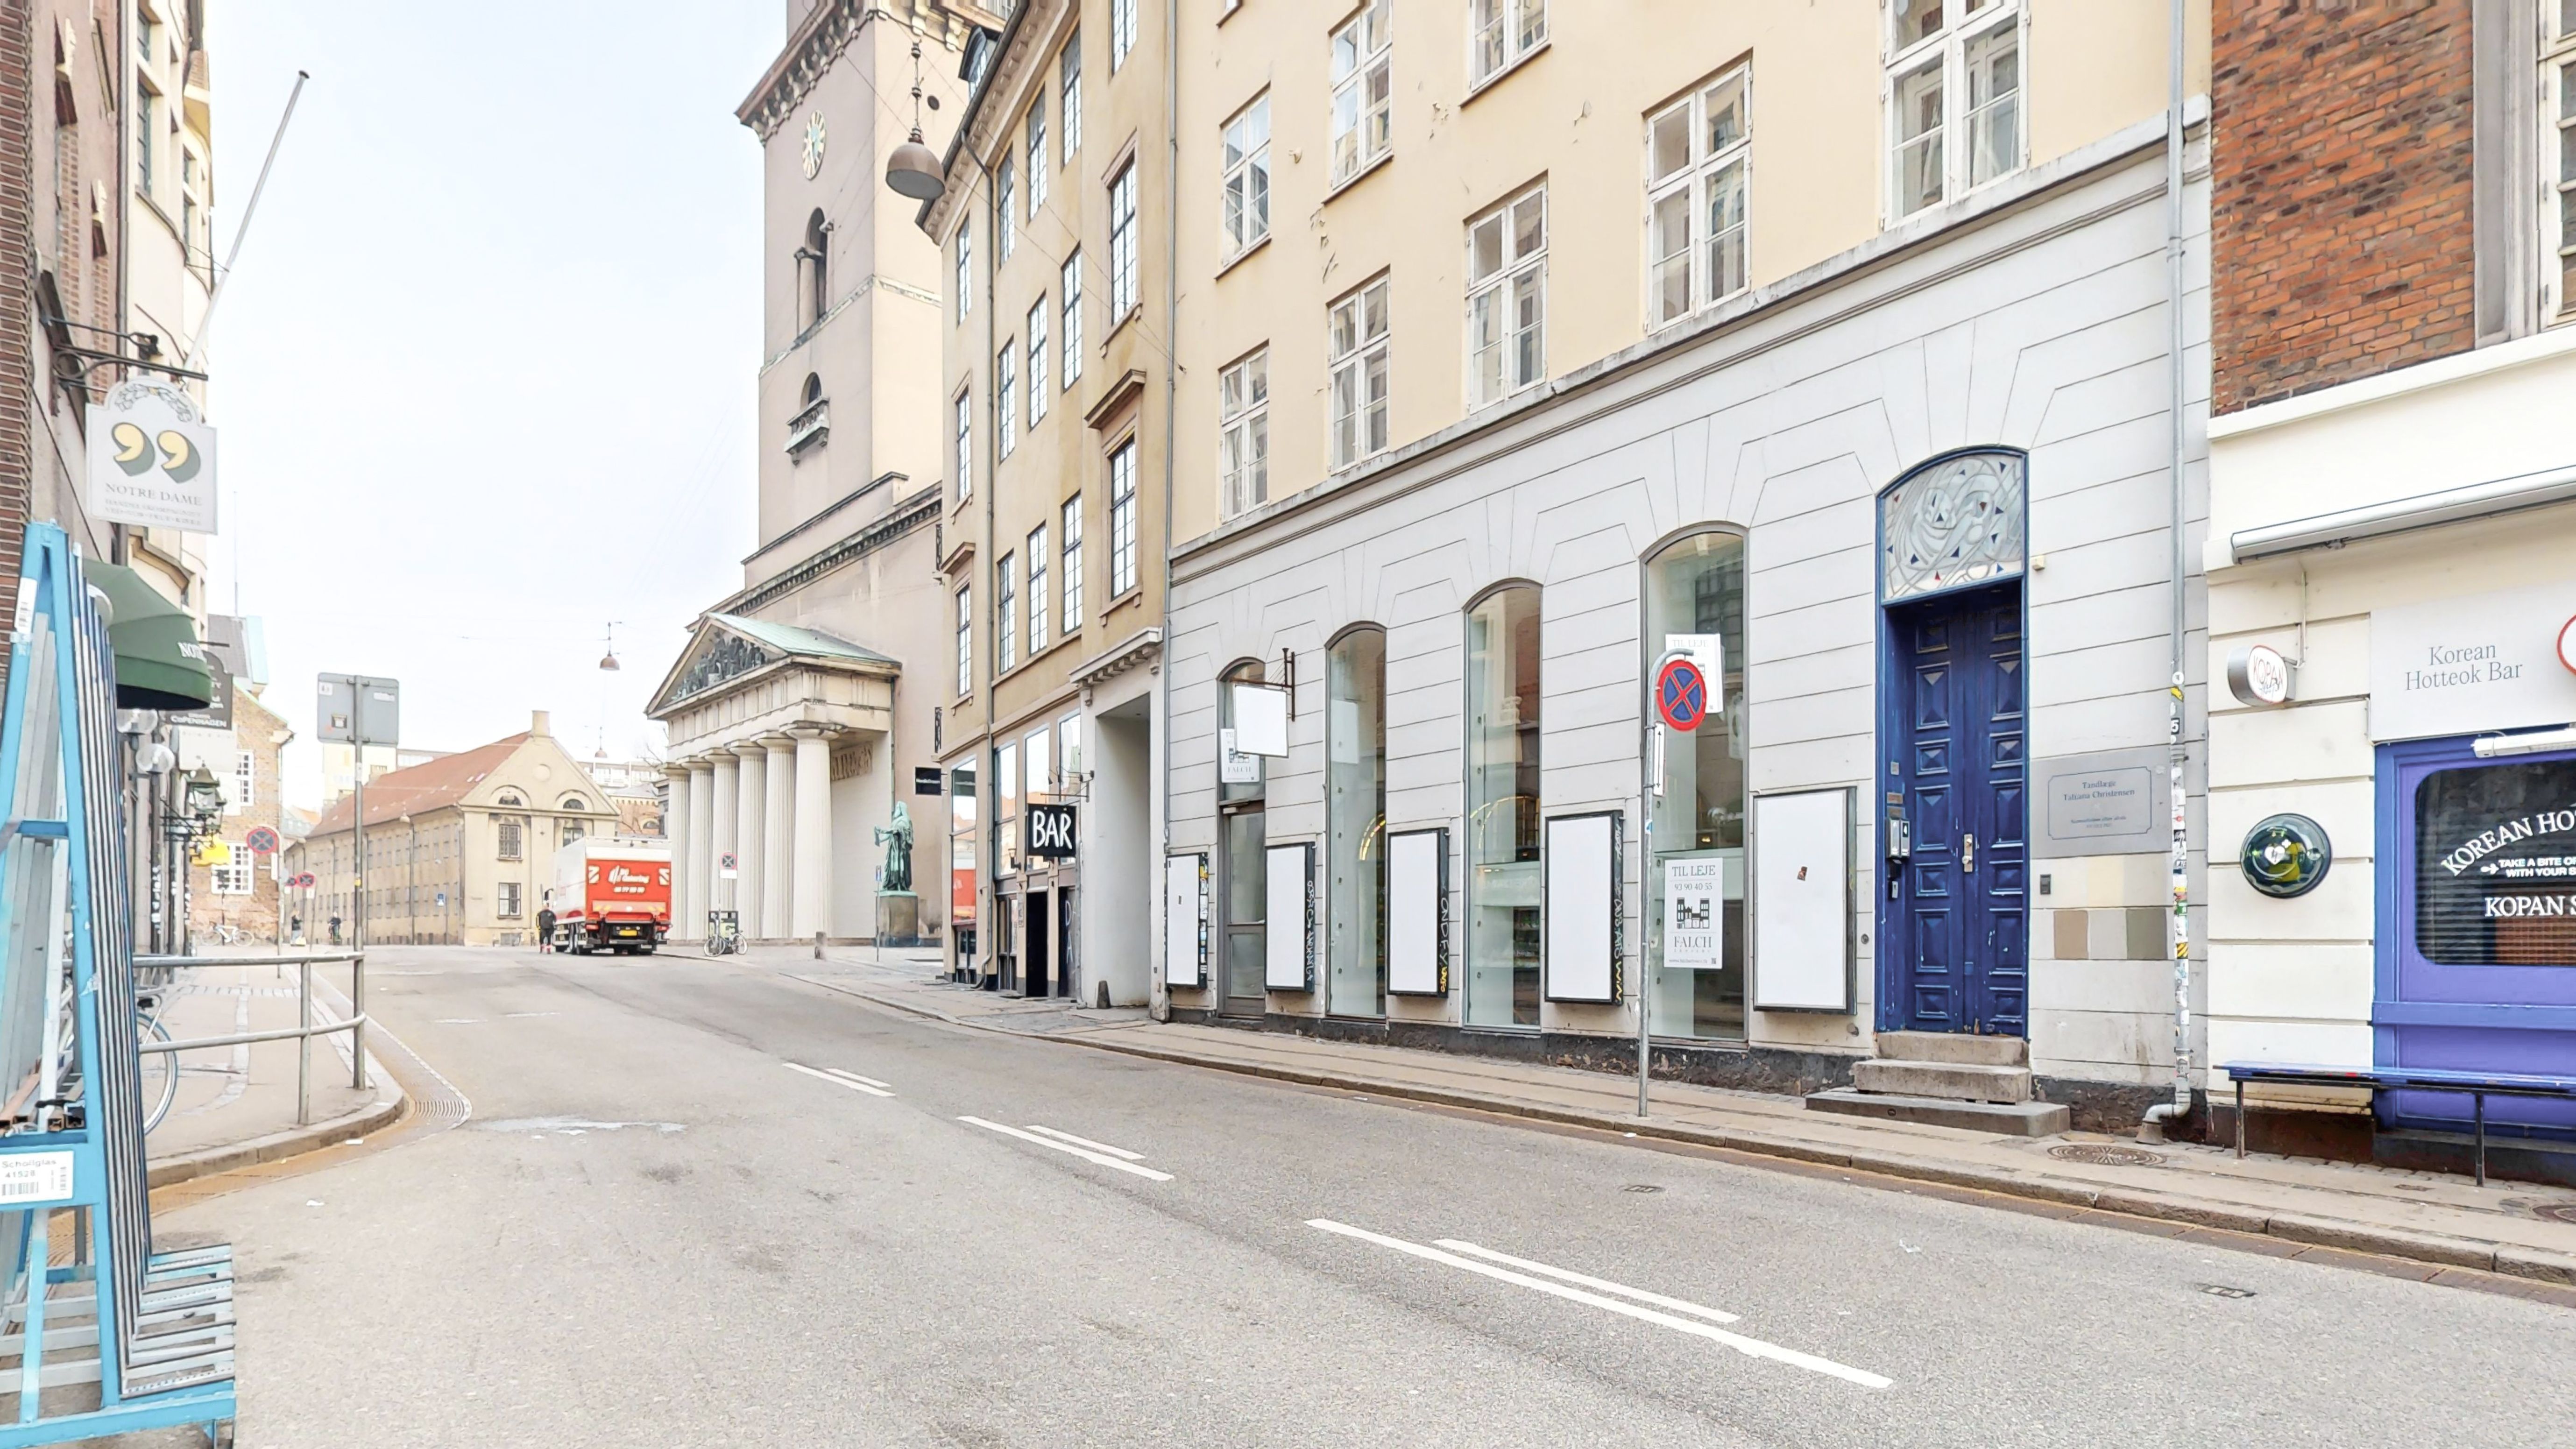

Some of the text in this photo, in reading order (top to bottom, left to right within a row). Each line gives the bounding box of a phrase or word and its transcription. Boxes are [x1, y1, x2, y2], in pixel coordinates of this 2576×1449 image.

[105, 482, 202, 506] NOTRE DAME
[2428, 645, 2497, 666] Korean
[2405, 661, 2523, 691] Hotteok Bar
[2092, 789, 2135, 798] Christensen
[1033, 810, 1073, 849] BAR
[2441, 810, 2576, 876] KOREAN HO
[1672, 865, 1716, 877] TIL LEJE
[2498, 858, 2526, 868] TAKE
[2527, 858, 2536, 867] A
[2537, 856, 2562, 867] BITE
[2506, 868, 2534, 878] WITH
[2535, 867, 2568, 876] YOUR
[2484, 895, 2566, 918] KOPAN
[1674, 936, 1712, 948] FALCH
